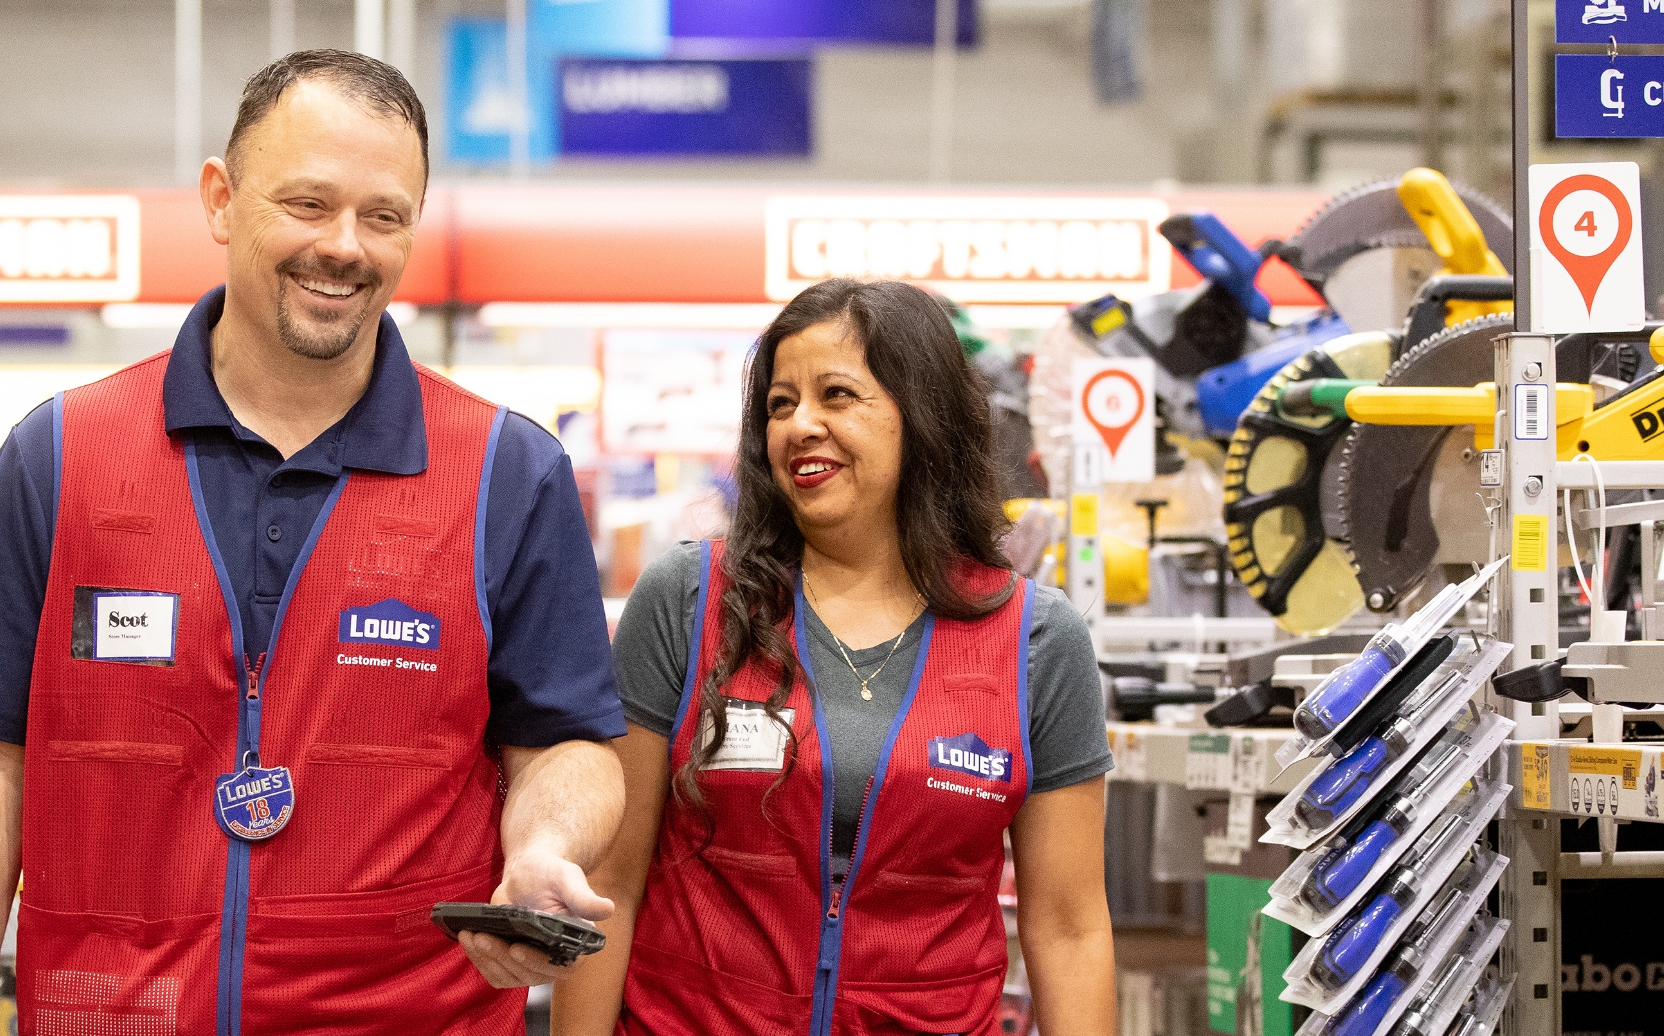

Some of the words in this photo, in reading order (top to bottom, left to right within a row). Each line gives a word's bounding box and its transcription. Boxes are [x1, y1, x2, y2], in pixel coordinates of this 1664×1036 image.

[1643, 81, 1664, 106] C
[1574, 210, 1598, 237] 4
[108, 610, 149, 628] Scot
[350, 614, 431, 644] LOWE'S
[337, 653, 393, 667] Customer
[395, 657, 438, 672] Service
[937, 742, 1005, 776] LOWE'S
[225, 773, 283, 803] LOWE'S
[927, 777, 974, 796] Customer
[976, 787, 1007, 803] Service
[246, 798, 271, 821] 18
